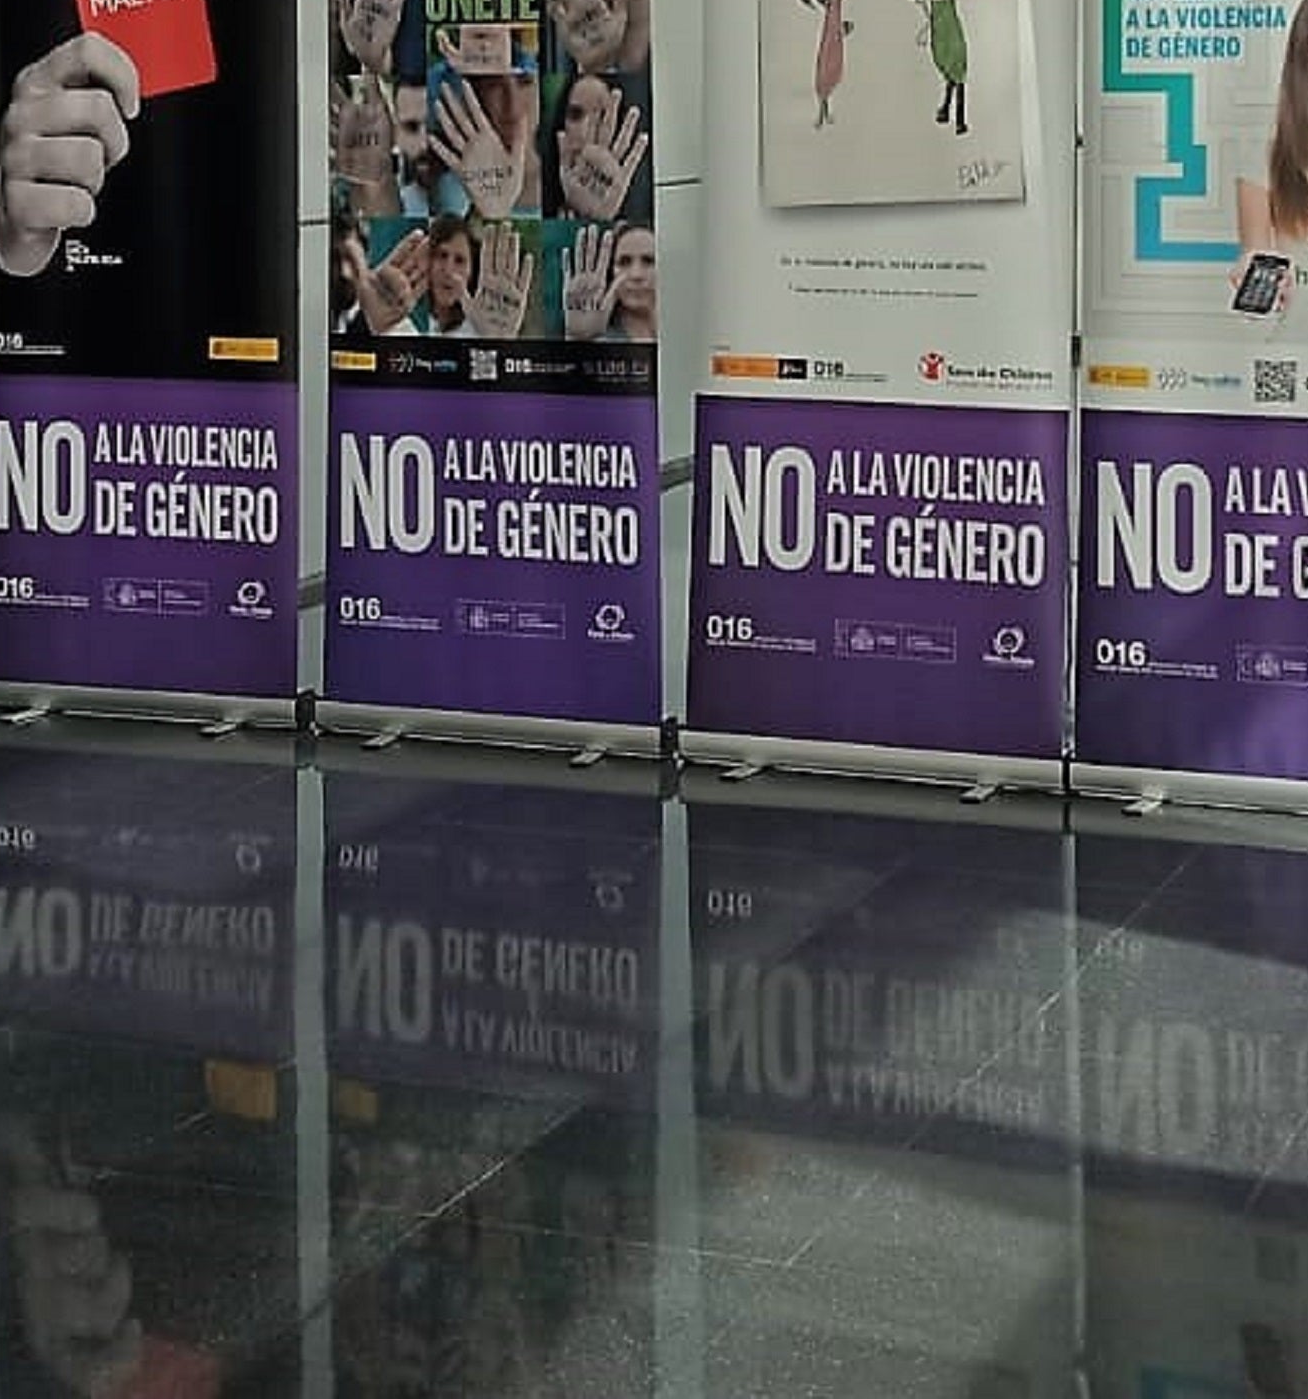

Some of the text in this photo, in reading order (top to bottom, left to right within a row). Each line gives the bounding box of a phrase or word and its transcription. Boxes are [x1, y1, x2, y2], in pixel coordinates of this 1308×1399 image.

[1126, 6, 1287, 30] A LA VIOLENCIA
[1126, 32, 1241, 59] DE GÉNERO
[94, 422, 279, 471] A LA VIOLENCIA
[443, 438, 637, 489] A LA VIOLENCIA
[340, 432, 436, 554] NO
[827, 450, 1046, 507] A LA VIOLENCIA
[1225, 466, 1246, 514] A
[1252, 467, 1291, 516] LA
[95, 471, 279, 545] DE GÉNERO
[444, 487, 639, 566] DE GÉNERO
[708, 443, 816, 572] NO
[1096, 460, 1213, 595] NO
[826, 503, 1045, 588] DE GÉNERO
[1224, 532, 1281, 598] DE
[340, 597, 381, 620] 016
[706, 615, 754, 642] 016
[1096, 638, 1147, 666] 016
